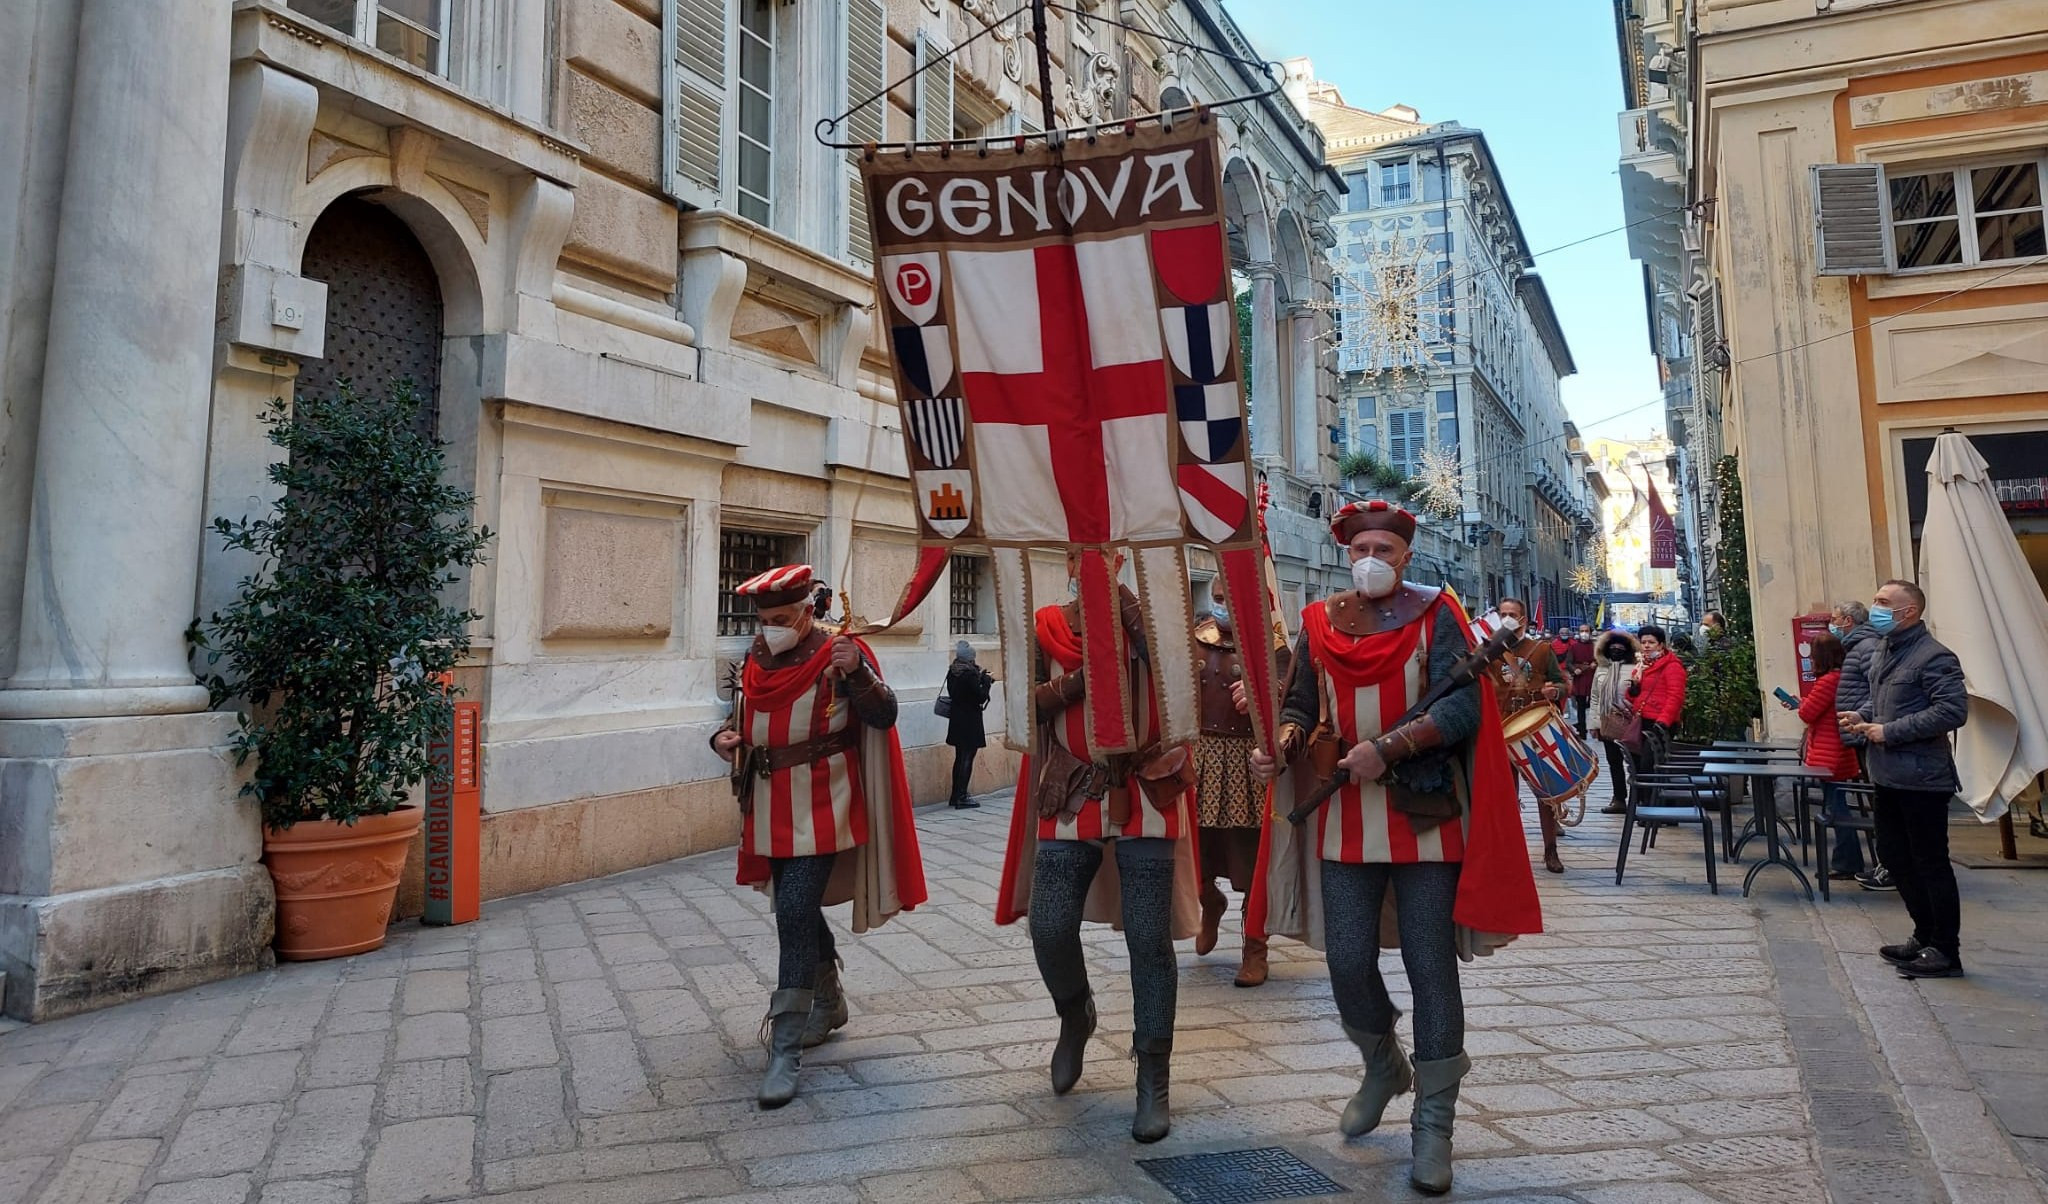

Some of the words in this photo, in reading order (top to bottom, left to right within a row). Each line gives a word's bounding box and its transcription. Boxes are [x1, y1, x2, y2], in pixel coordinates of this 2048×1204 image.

[885, 149, 1204, 237] GENOVA
[900, 269, 927, 300] P
[285, 307, 295, 322] 9
[429, 728, 449, 901] #CAMBIAGST
